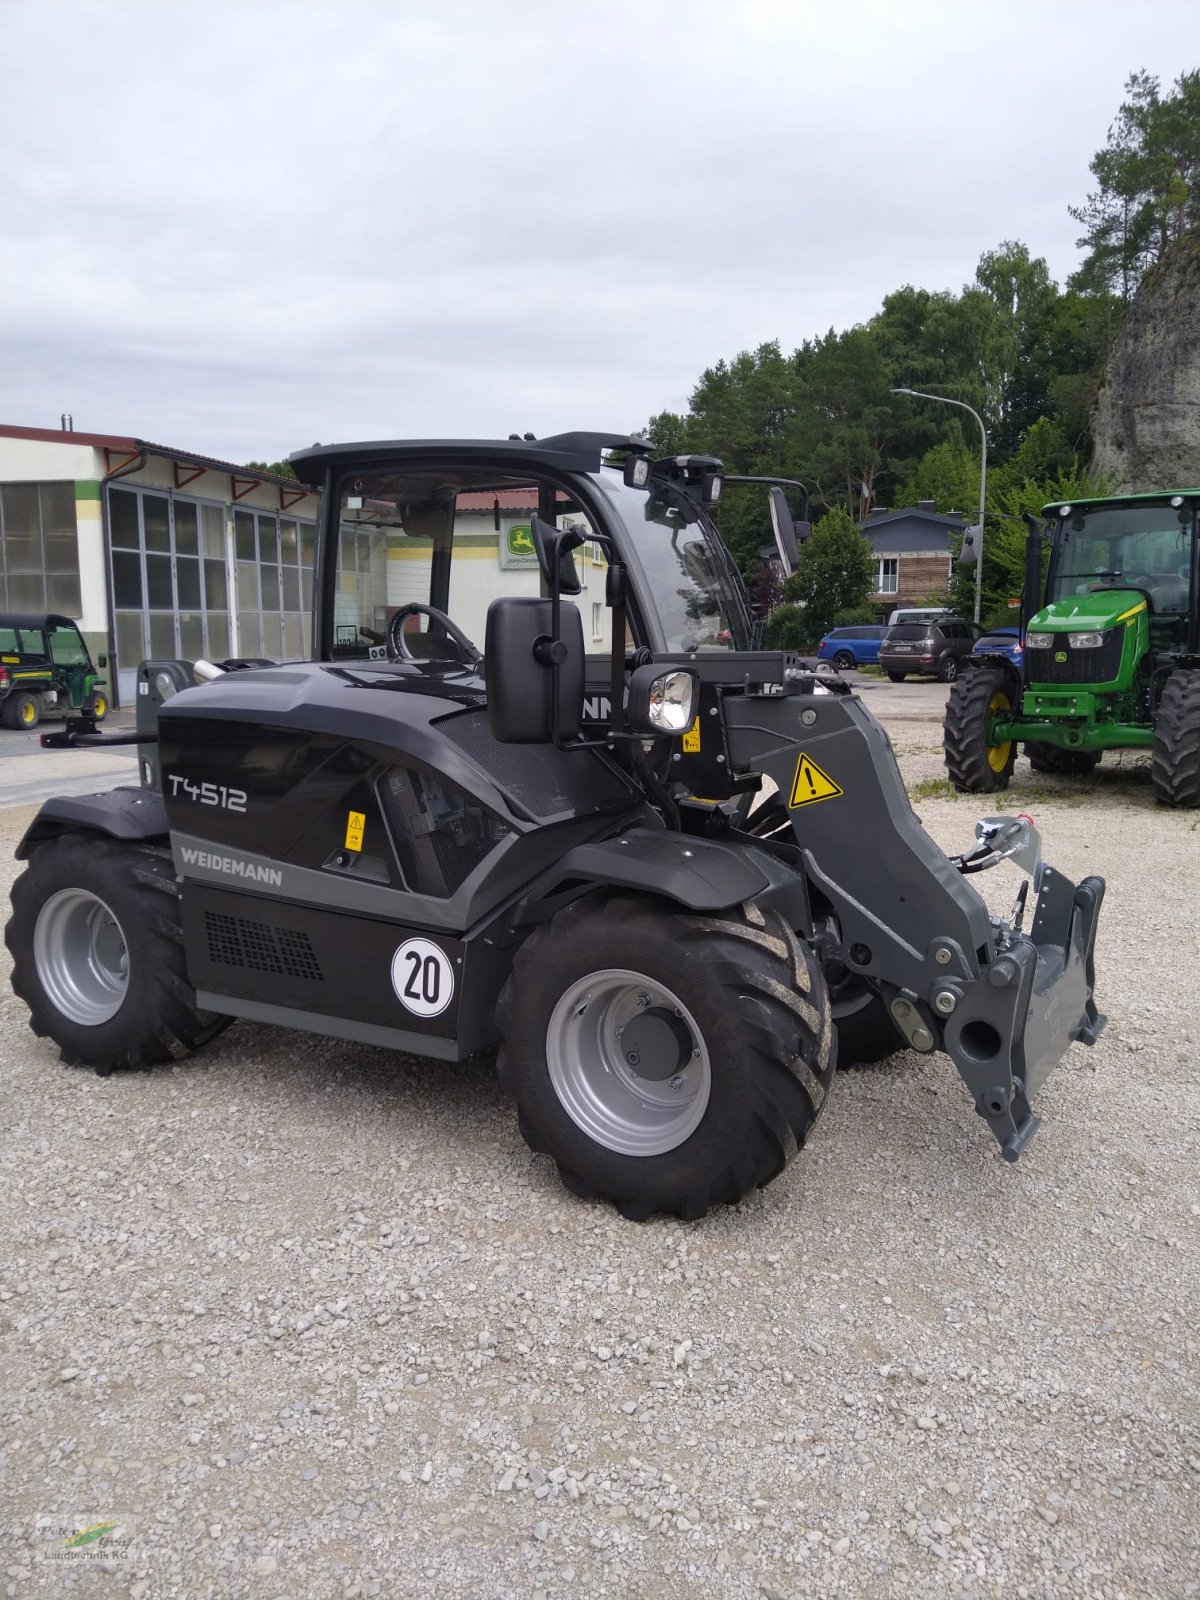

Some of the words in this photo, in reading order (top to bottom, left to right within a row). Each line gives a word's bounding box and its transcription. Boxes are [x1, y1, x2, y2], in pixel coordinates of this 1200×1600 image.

[168, 774, 247, 812] T4512
[181, 847, 282, 886] WEIDEMANN
[404, 950, 440, 1004] 20
